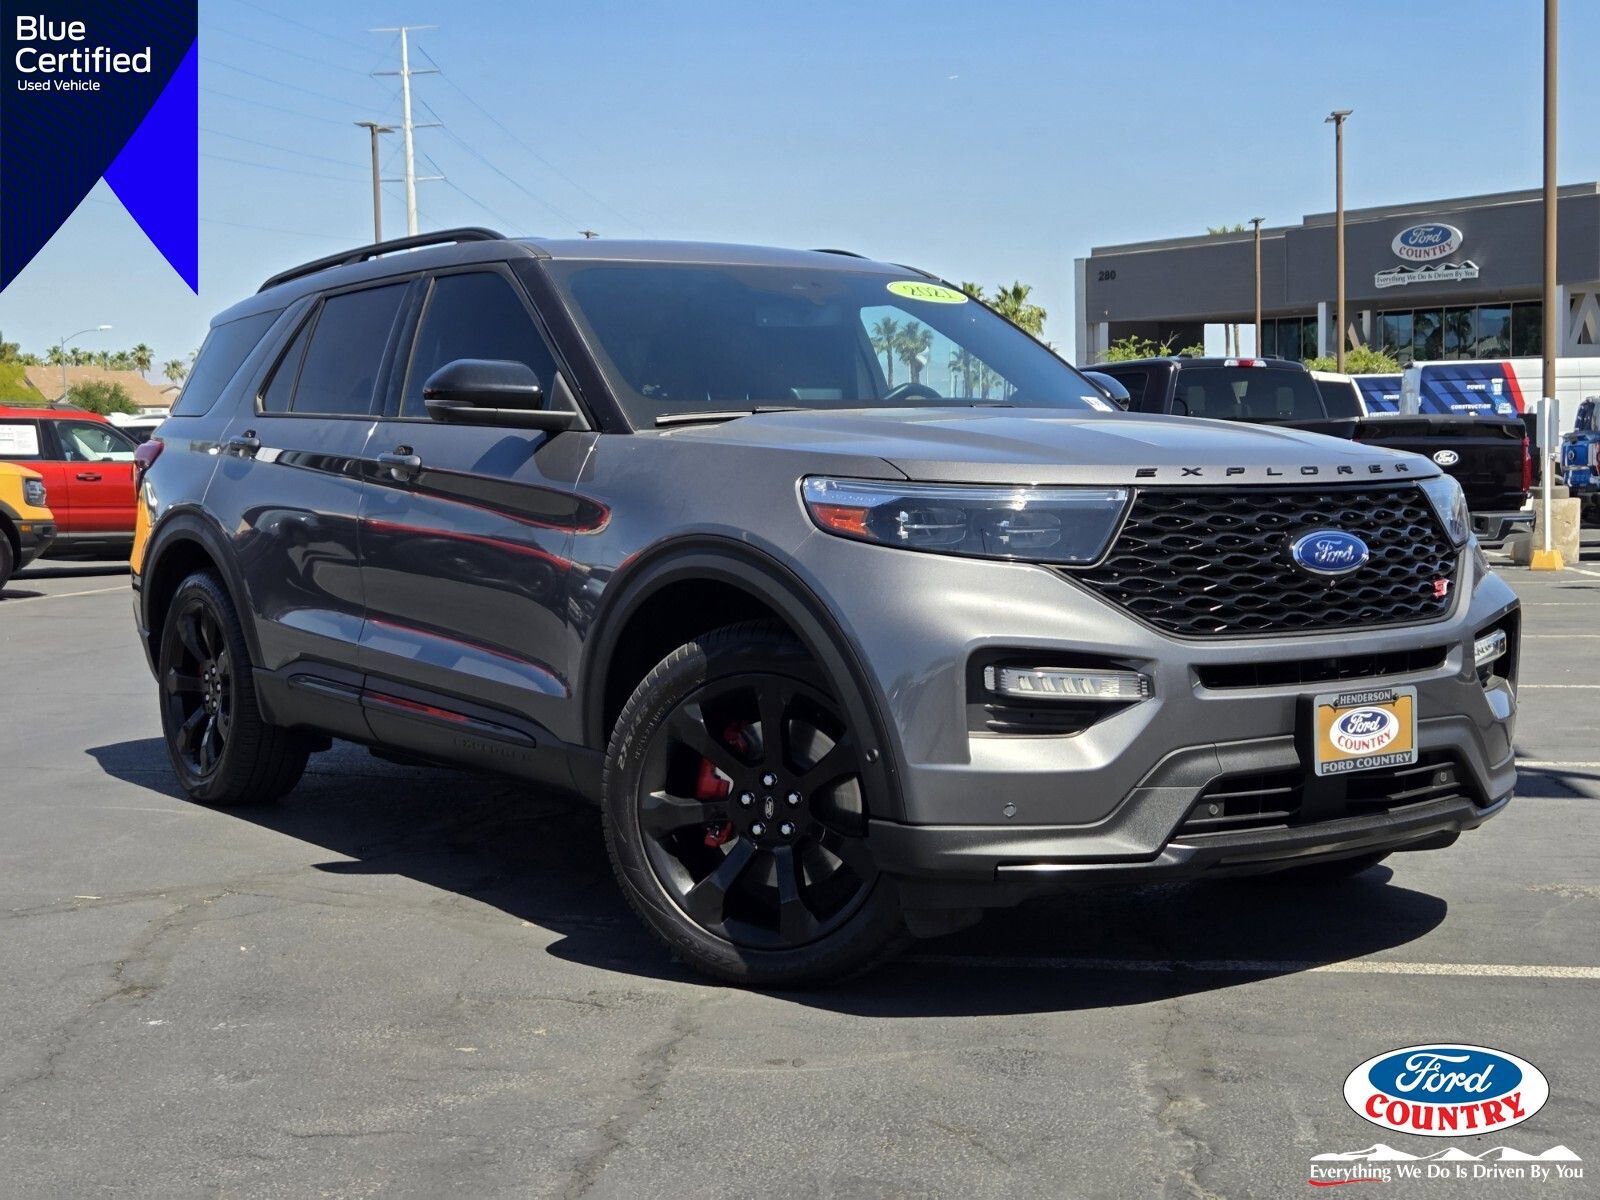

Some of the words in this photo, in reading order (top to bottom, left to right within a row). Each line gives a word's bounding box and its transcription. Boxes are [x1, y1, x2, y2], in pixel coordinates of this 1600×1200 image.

[1408, 227, 1442, 245] Ford
[1399, 241, 1453, 258] COUNTRY
[1098, 270, 1117, 281] 280
[1376, 274, 1405, 284] Everything
[1455, 271, 1462, 281] By
[1135, 463, 1409, 477] EXPLORER
[1314, 540, 1354, 563] Ford
[1340, 691, 1391, 705] HENDERSON
[1347, 712, 1381, 734] Ford
[1337, 729, 1391, 751] COUNTRY
[1322, 761, 1354, 773] FORD
[1356, 753, 1411, 768] COUNTRY
